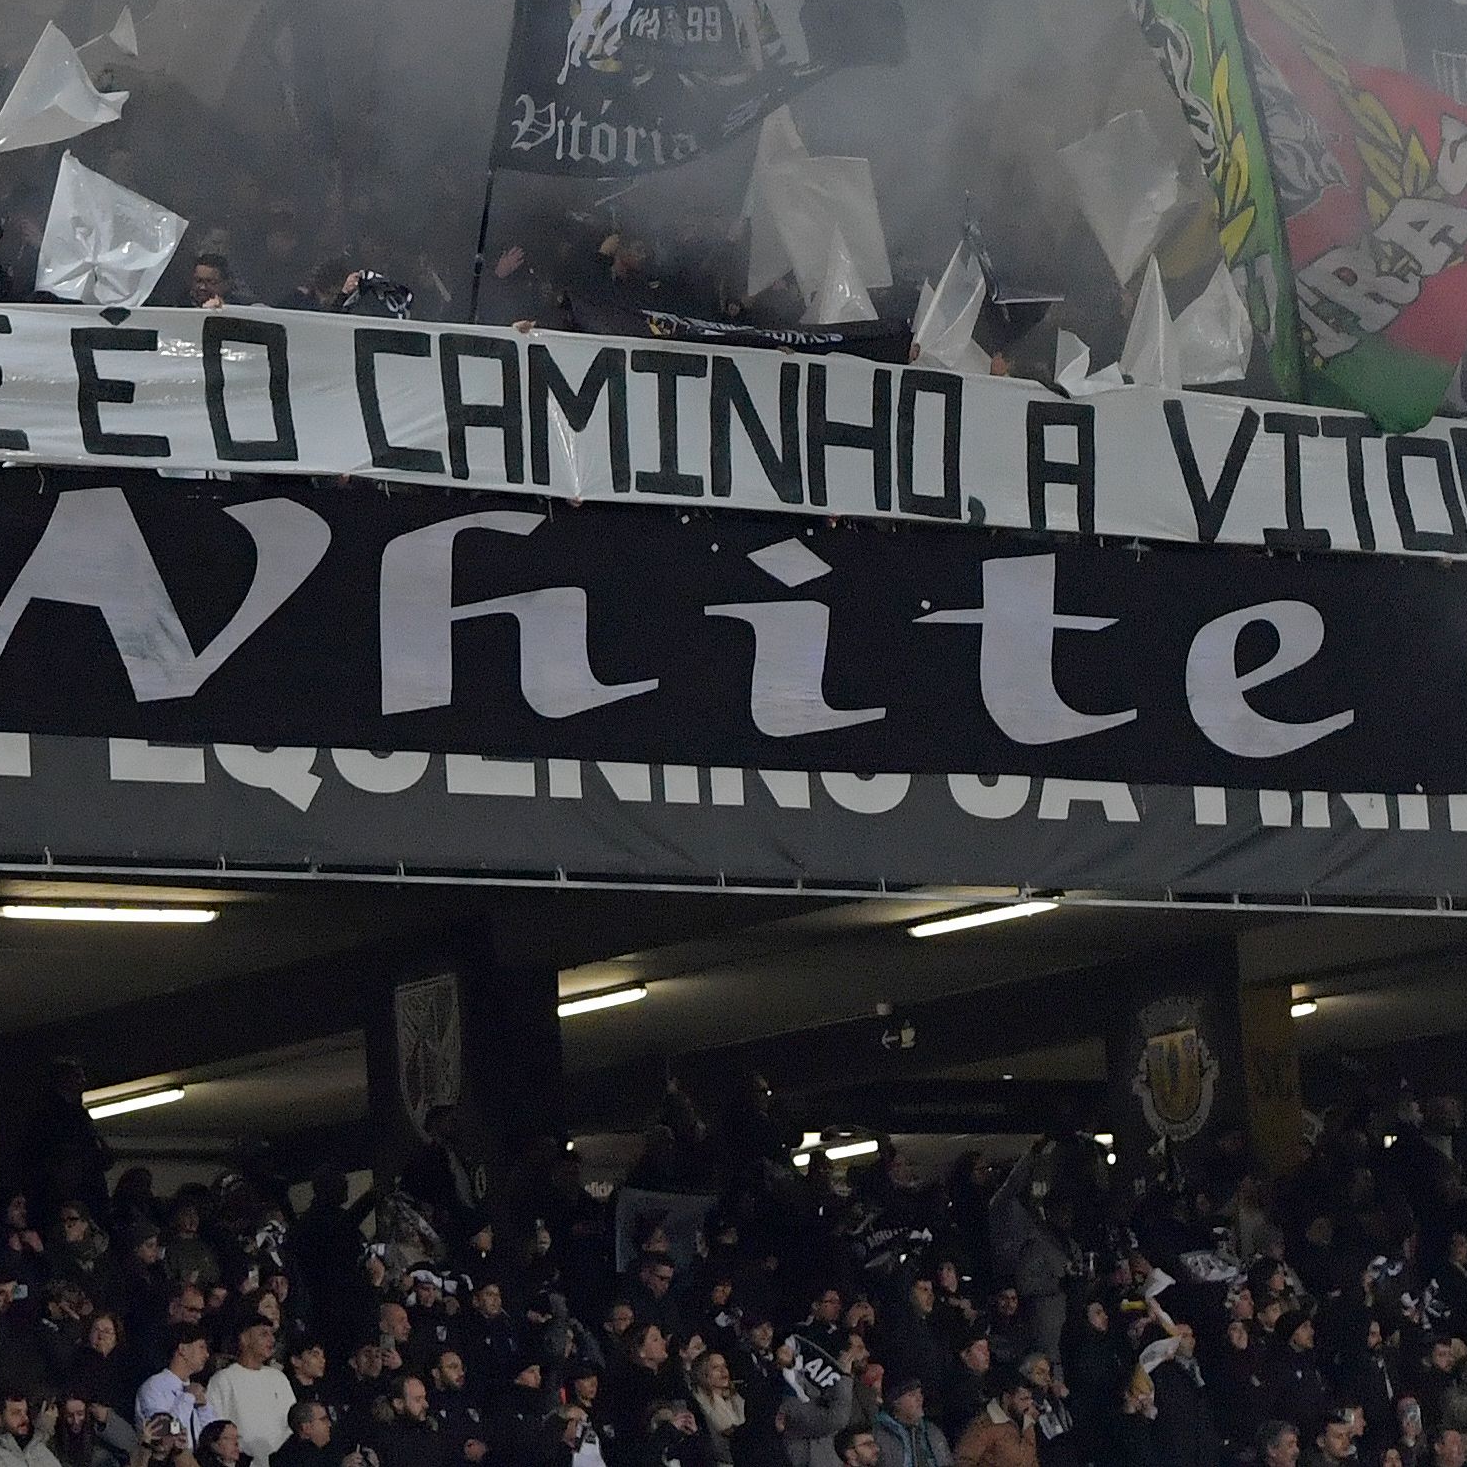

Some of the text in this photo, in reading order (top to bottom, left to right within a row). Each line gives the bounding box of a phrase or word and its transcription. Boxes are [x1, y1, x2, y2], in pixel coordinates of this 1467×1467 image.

[70, 306, 172, 459] É
[202, 316, 299, 463] O
[1026, 400, 1096, 534] A
